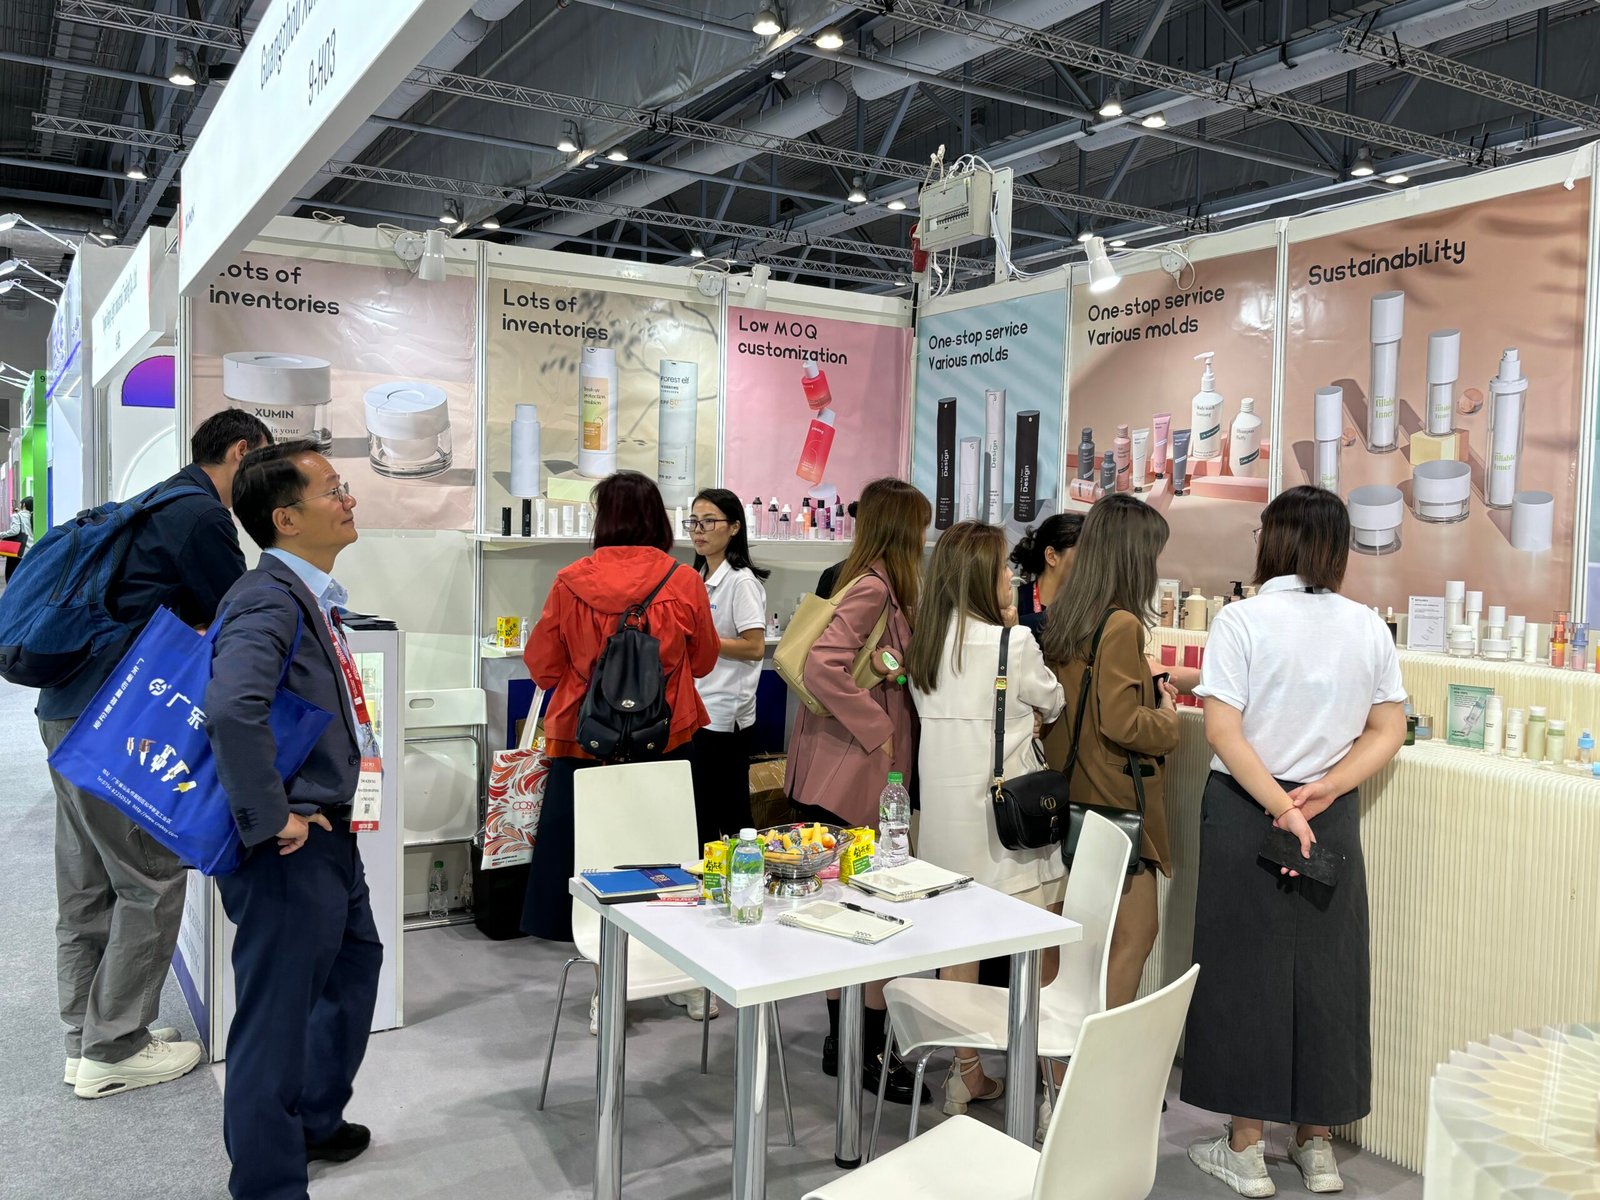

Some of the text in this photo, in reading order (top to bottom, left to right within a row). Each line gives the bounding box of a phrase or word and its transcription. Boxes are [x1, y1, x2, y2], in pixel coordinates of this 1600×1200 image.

[309, 28, 336, 106] 9-H03
[219, 260, 302, 284] ots of
[1308, 238, 1466, 286] Sustainability
[209, 284, 340, 315] inventories
[503, 288, 577, 313] Lots of
[1088, 286, 1225, 322] One-stop service
[502, 313, 608, 341] inventories
[738, 315, 818, 340] Low MOQ
[928, 320, 1028, 350] One-stop service
[1087, 315, 1199, 346] Various molds
[737, 341, 848, 365] customization
[928, 346, 1009, 371] Various molds
[40, 375, 46, 383] 9
[255, 408, 294, 419] XUMIN
[280, 427, 300, 436] your
[166, 692, 208, 731] 广东
